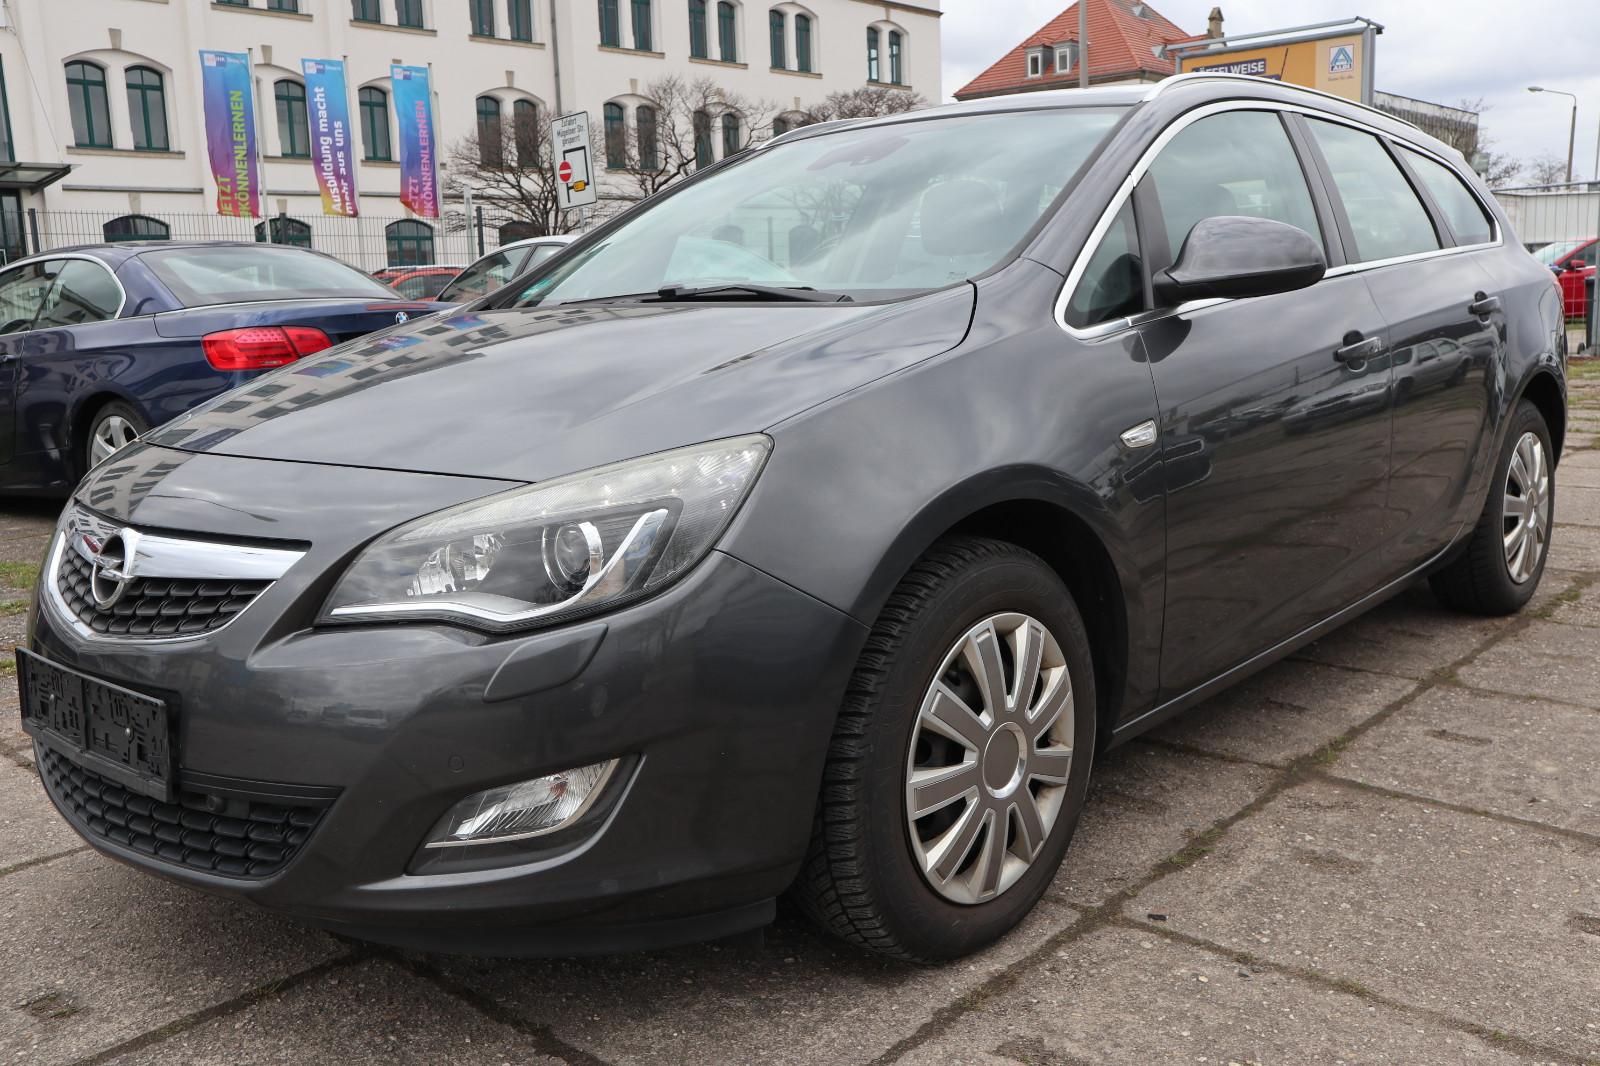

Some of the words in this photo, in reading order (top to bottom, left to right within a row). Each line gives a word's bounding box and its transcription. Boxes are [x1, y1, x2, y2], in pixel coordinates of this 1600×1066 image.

[314, 86, 329, 132] macht
[333, 120, 344, 147] uns
[319, 136, 341, 212] Ausbildung
[336, 151, 346, 175] aus
